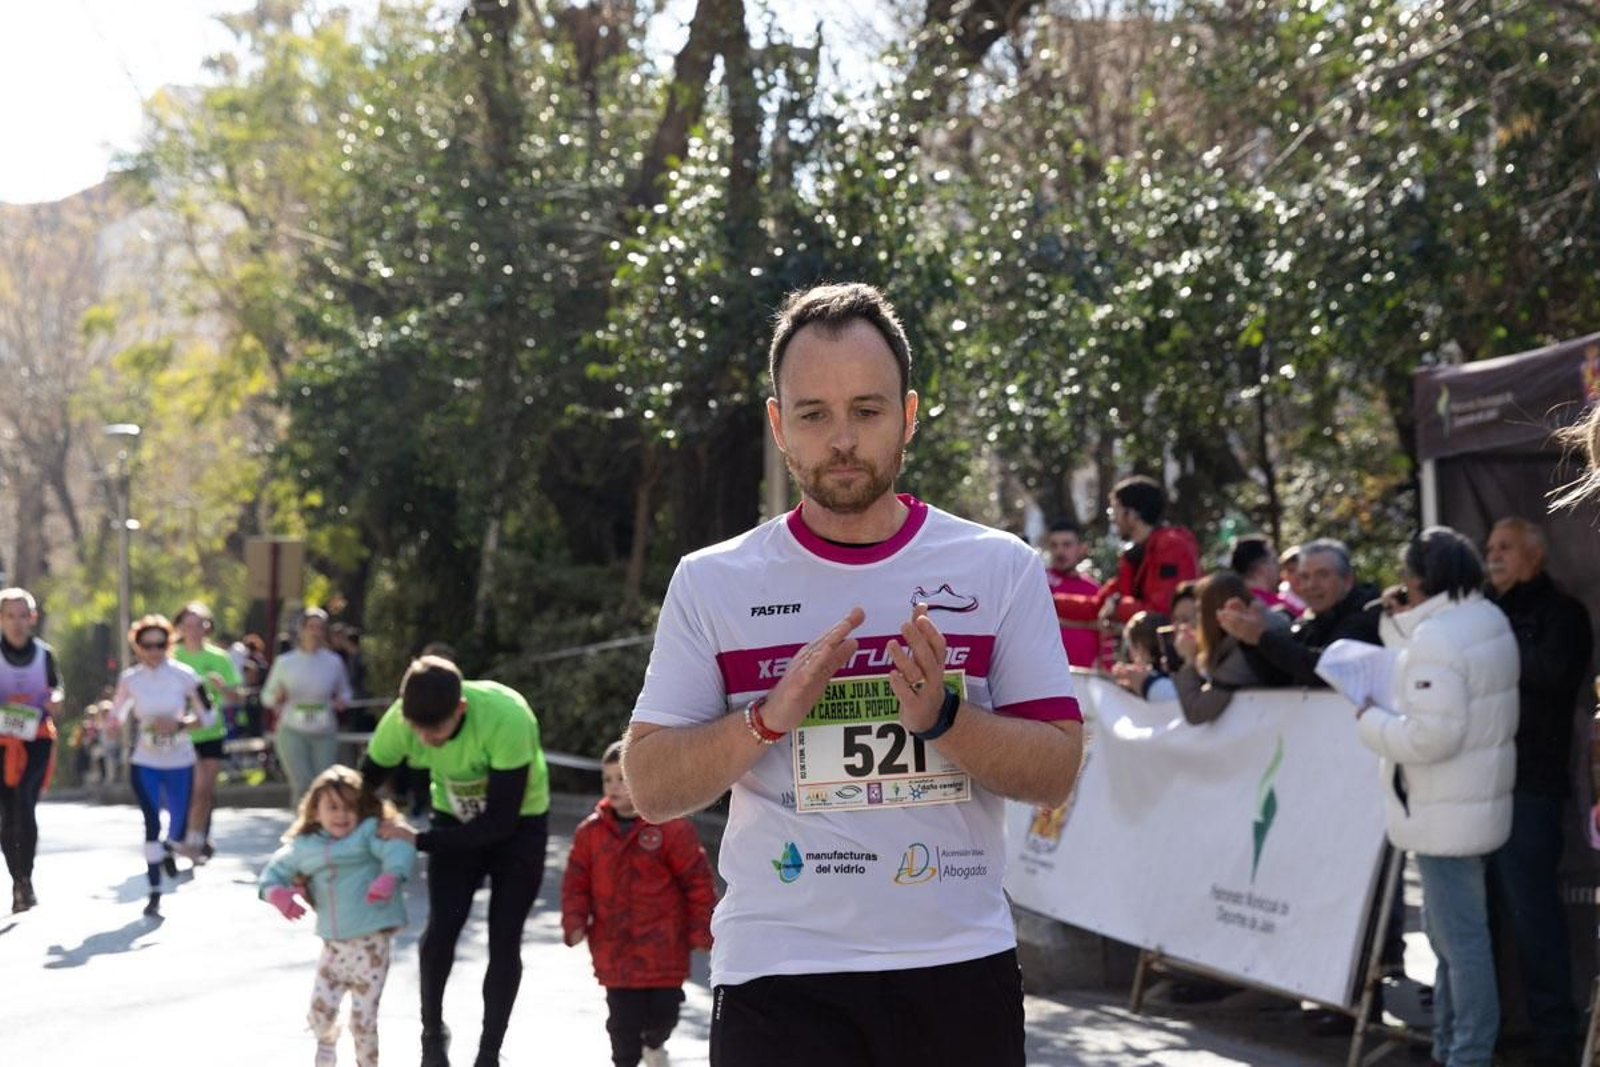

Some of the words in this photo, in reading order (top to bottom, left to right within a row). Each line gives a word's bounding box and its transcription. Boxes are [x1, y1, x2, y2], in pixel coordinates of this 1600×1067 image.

[750, 603, 801, 617] FASTER
[825, 684, 846, 700] SAN
[850, 682, 879, 699] JUAN
[819, 701, 862, 719] CARRERA
[843, 723, 926, 777] 521
[806, 851, 878, 861] manufacturas
[815, 864, 831, 874] del
[834, 864, 866, 874] vidrio
[943, 864, 988, 880] Abogados
